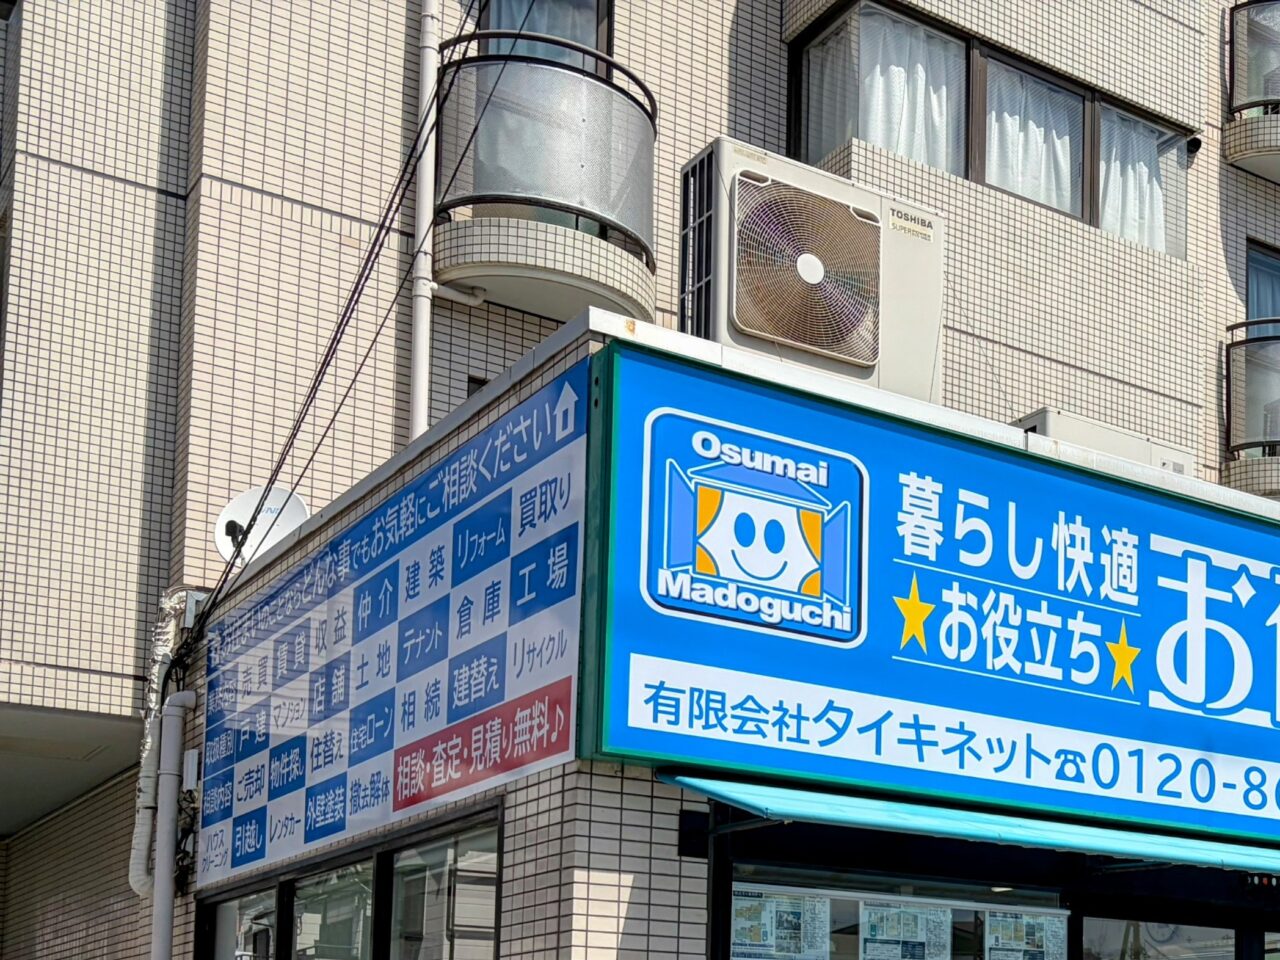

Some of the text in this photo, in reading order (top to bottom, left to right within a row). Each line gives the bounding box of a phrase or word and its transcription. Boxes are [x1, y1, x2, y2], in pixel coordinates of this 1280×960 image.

[890, 208, 933, 229] TOSHIBA
[691, 431, 828, 488] Osumai
[518, 472, 571, 537] 買取り
[458, 518, 506, 569] リフォーム
[897, 472, 1139, 607] 暮らし快適
[405, 545, 445, 602] 建築
[517, 541, 569, 606] 工場
[357, 579, 393, 632] 仲介
[456, 580, 501, 639] 倉庫
[657, 568, 852, 632] Madoguchi
[403, 622, 443, 665] テナント
[514, 629, 568, 679] リサイクル
[938, 582, 1101, 685] お役立ち
[313, 665, 345, 716] 店舗
[355, 640, 391, 691] 土地
[453, 655, 499, 709] 建替え
[239, 710, 266, 751] 戸建
[273, 697, 305, 730] マンション
[350, 706, 393, 755] 住宅ローン
[401, 678, 441, 732] 相続
[643, 681, 1053, 779] 有限会社タイキネット
[270, 747, 304, 791] 物件探し
[310, 729, 344, 773] 住替え
[236, 764, 265, 801] ご売却
[270, 813, 302, 843] レンタカー
[306, 786, 345, 831] 外壁塗装
[235, 819, 263, 858] 引越し
